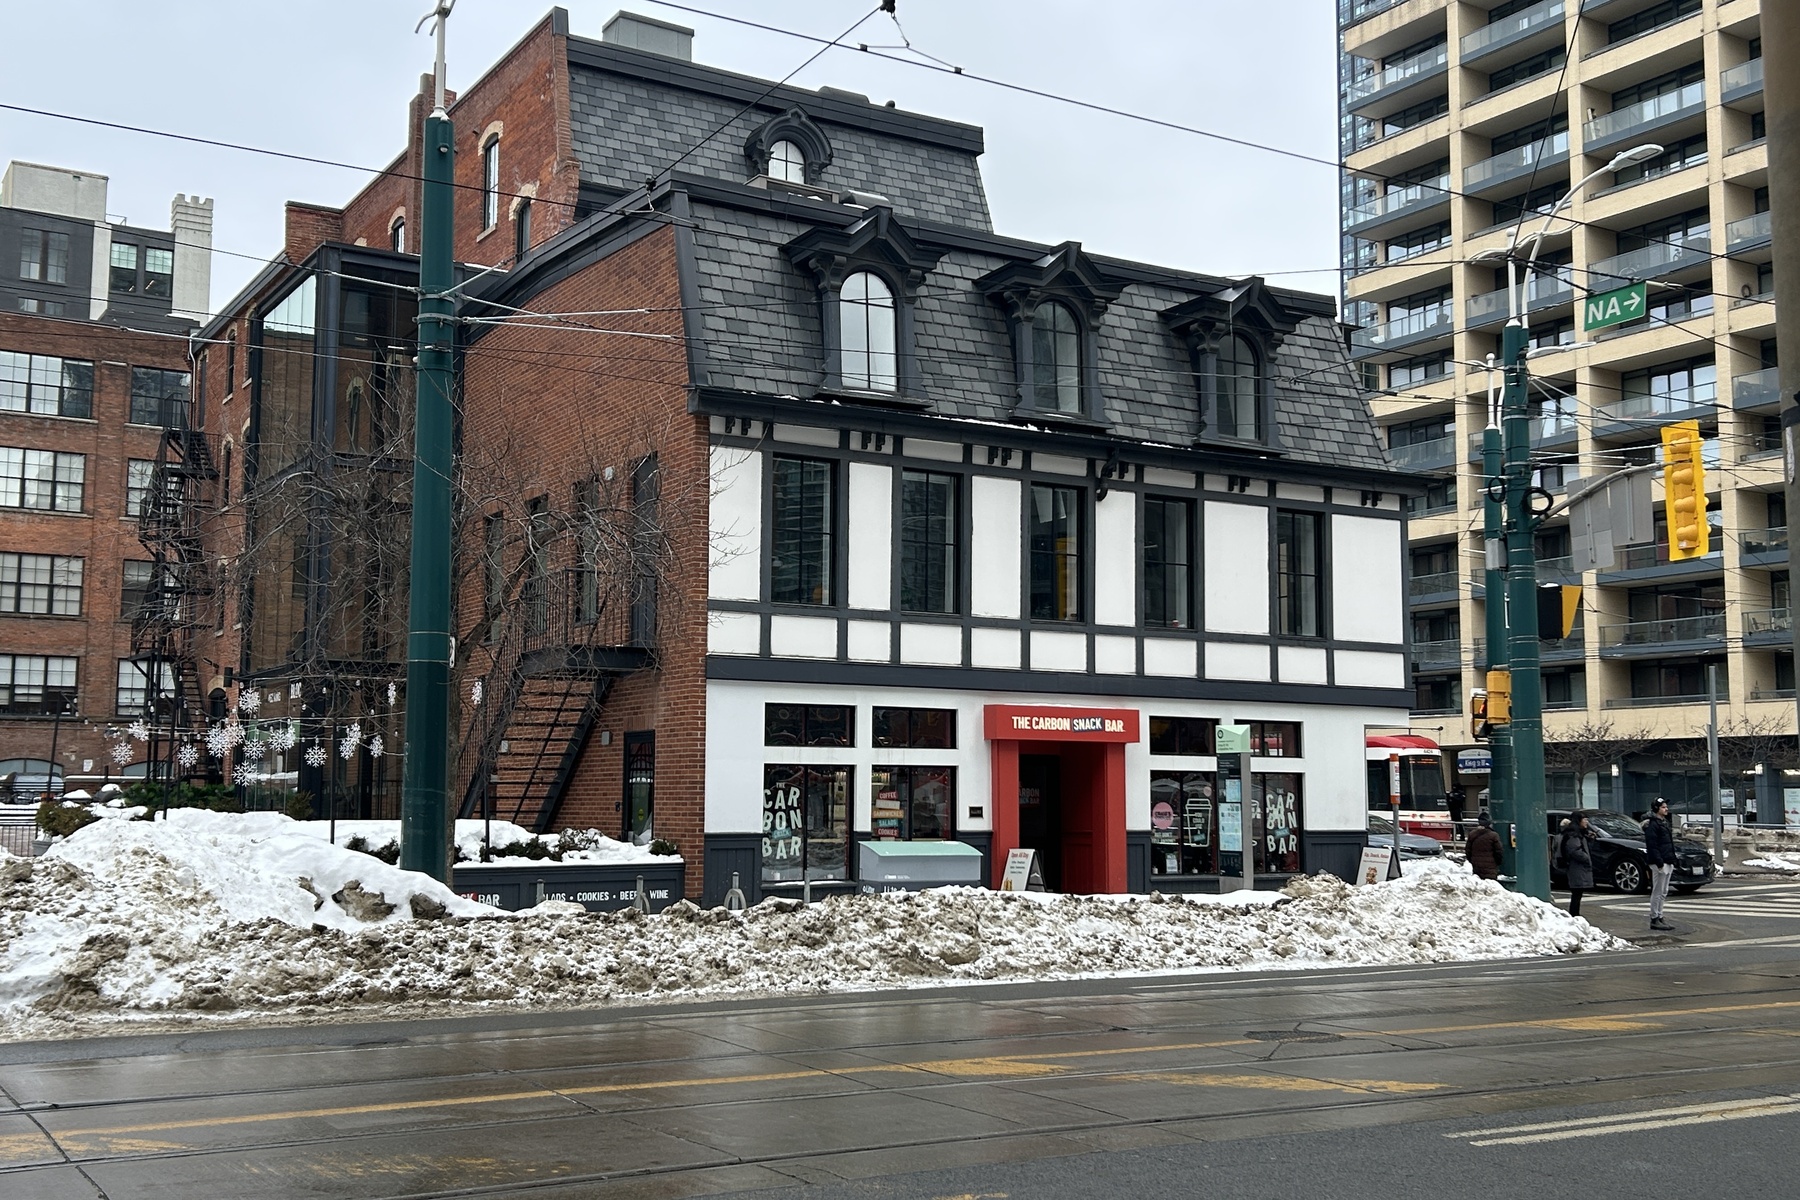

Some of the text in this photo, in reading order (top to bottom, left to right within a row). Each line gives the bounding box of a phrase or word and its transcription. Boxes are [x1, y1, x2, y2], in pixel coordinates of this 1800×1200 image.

[1588, 297, 1621, 323] NA
[1012, 716, 1031, 729] THE
[1032, 717, 1070, 730] CARBON
[1073, 718, 1102, 730] SNACK
[763, 786, 800, 809] CAR
[879, 791, 897, 800] COFFEE
[763, 809, 802, 831] BON
[878, 828, 898, 837] COOKIES
[762, 836, 801, 859] BAR
[1267, 834, 1297, 854] BAR
[478, 894, 500, 906] BAR
[543, 893, 566, 902] LADS
[577, 891, 610, 901] COOKIES
[649, 889, 669, 899] WINE
